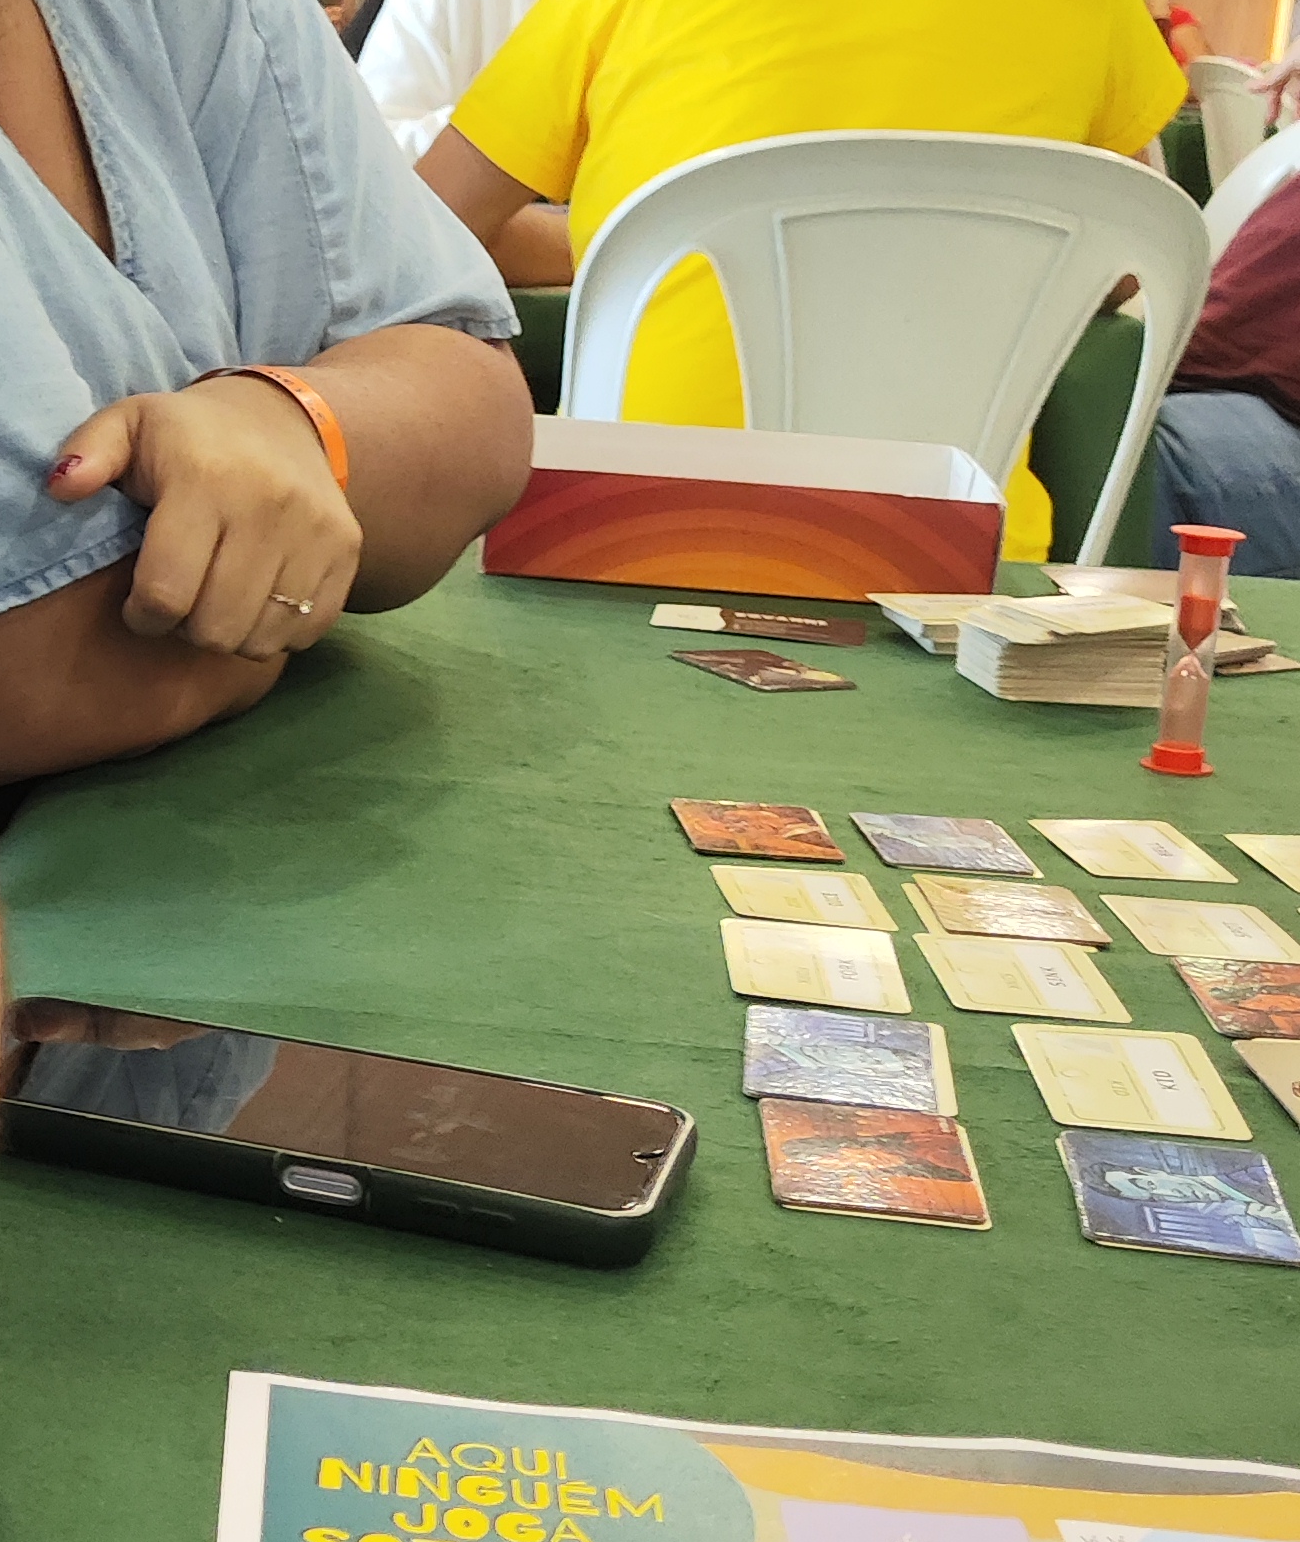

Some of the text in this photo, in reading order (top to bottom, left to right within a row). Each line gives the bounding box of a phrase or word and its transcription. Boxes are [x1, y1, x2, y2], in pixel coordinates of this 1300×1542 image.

[838, 959, 859, 981] FORK
[1039, 965, 1067, 988] SINK
[1151, 1069, 1179, 1093] KID
[406, 1436, 570, 1480] AQUI
[317, 1456, 665, 1523] NINGUÉM
